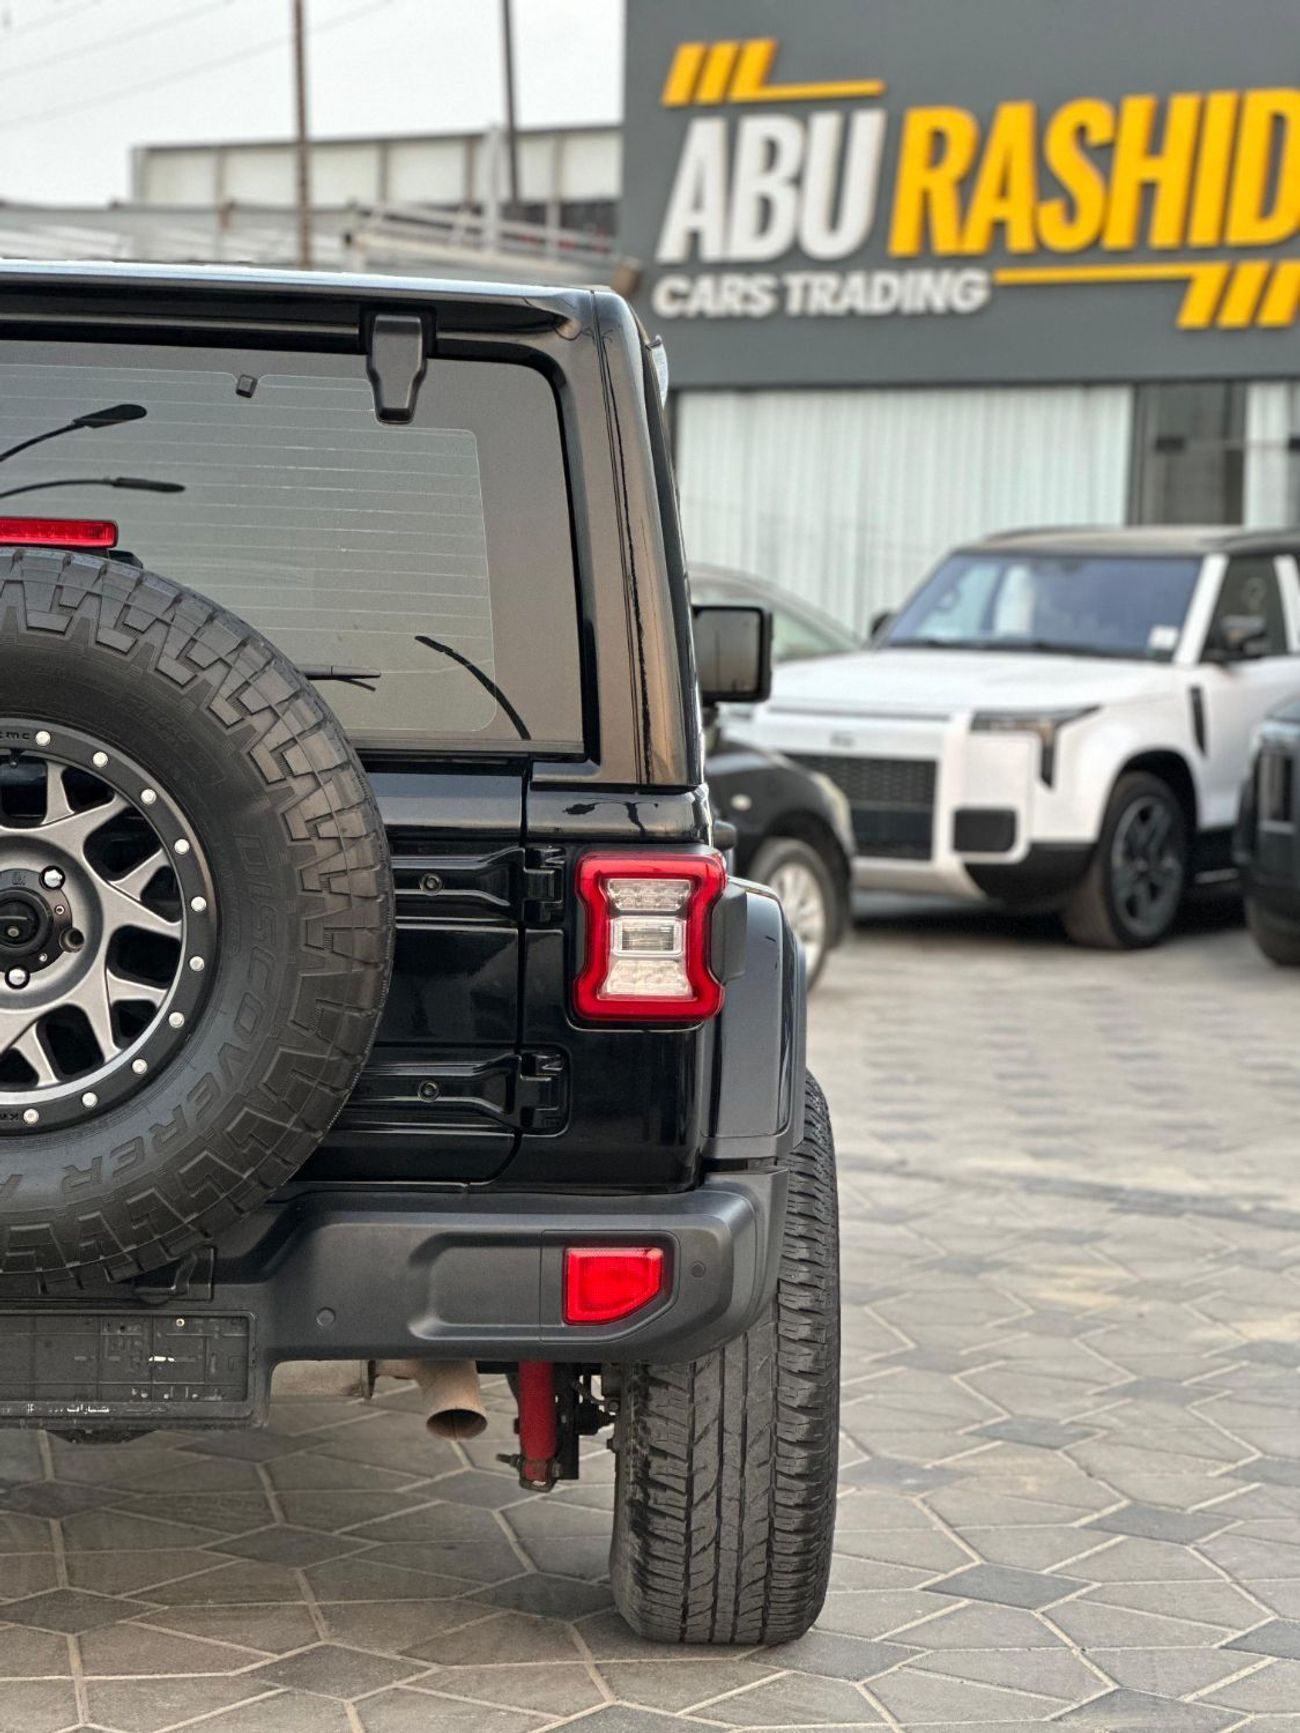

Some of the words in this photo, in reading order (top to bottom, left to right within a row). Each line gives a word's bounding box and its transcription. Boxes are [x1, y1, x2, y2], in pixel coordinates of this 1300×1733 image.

[656, 109, 887, 264] ABU
[887, 87, 1300, 258] RASHID
[652, 272, 778, 319] CARS
[782, 268, 991, 318] TRADING
[62, 833, 279, 1195] DISCOVERER
